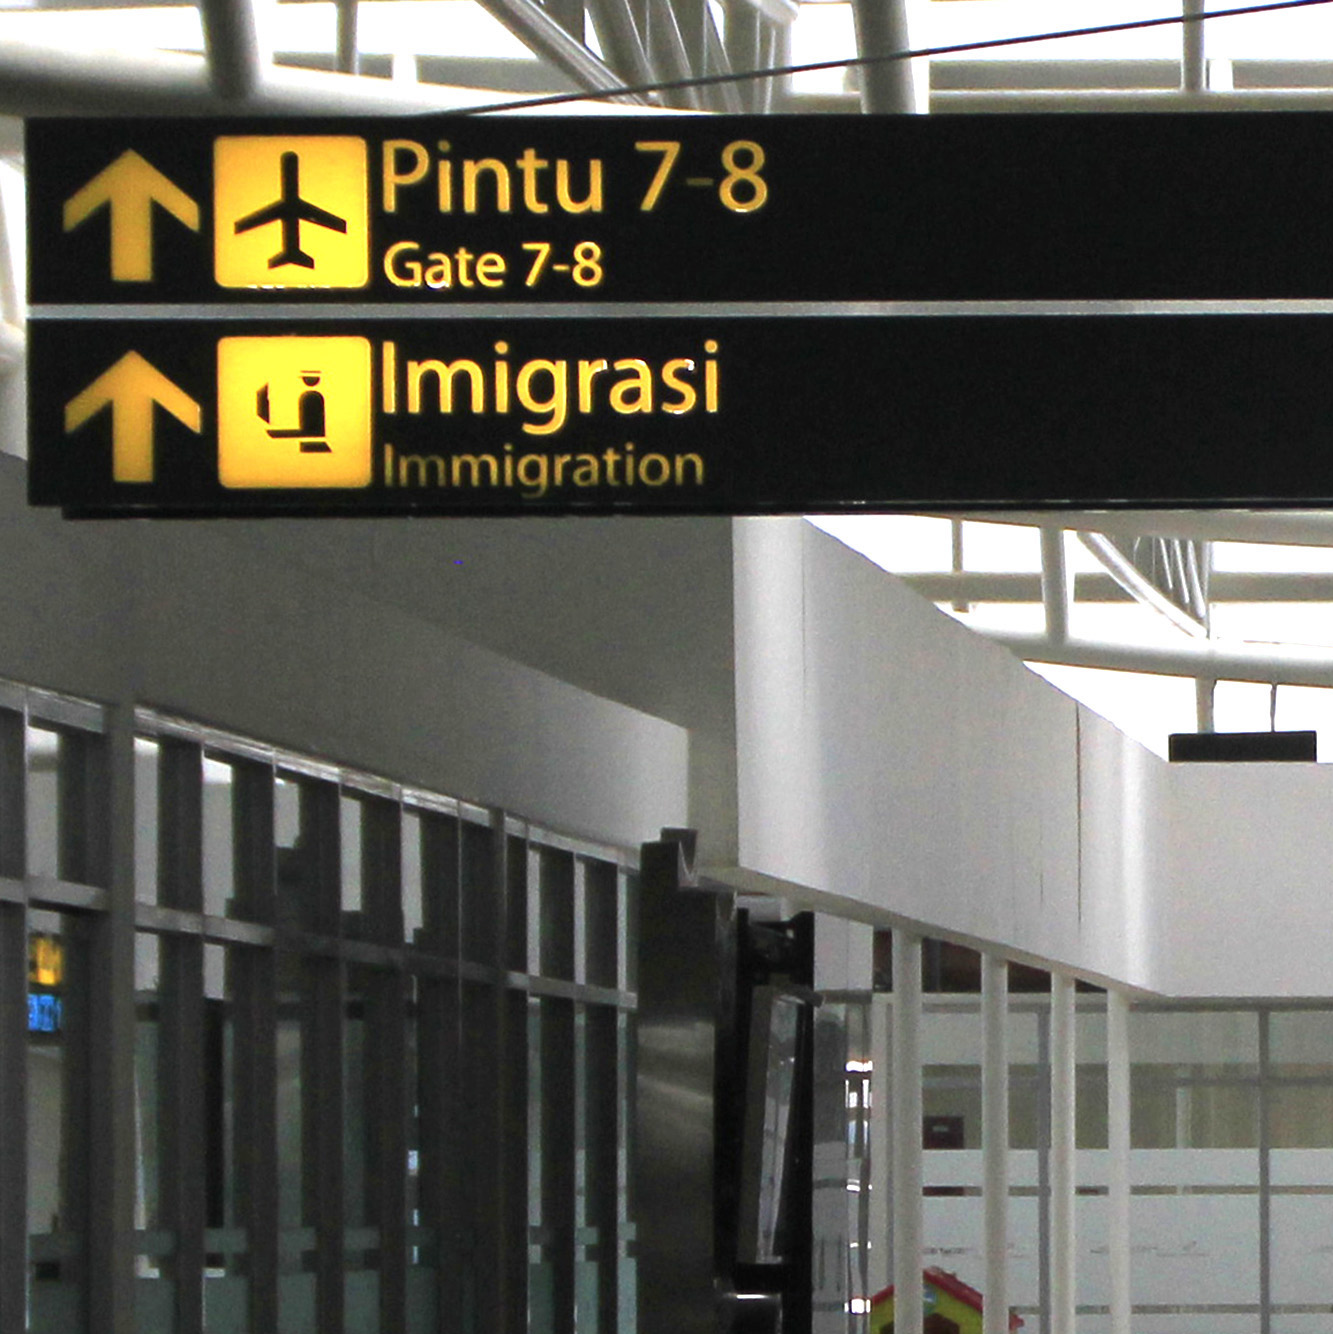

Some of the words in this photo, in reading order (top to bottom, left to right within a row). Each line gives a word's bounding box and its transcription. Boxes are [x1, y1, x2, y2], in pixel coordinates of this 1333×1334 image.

[382, 139, 603, 214] Pintu
[635, 140, 768, 213] 7-8
[383, 242, 507, 288] Gate
[522, 241, 604, 287] 7-8
[382, 339, 719, 435] Imigrasi
[384, 443, 703, 497] Immigration
